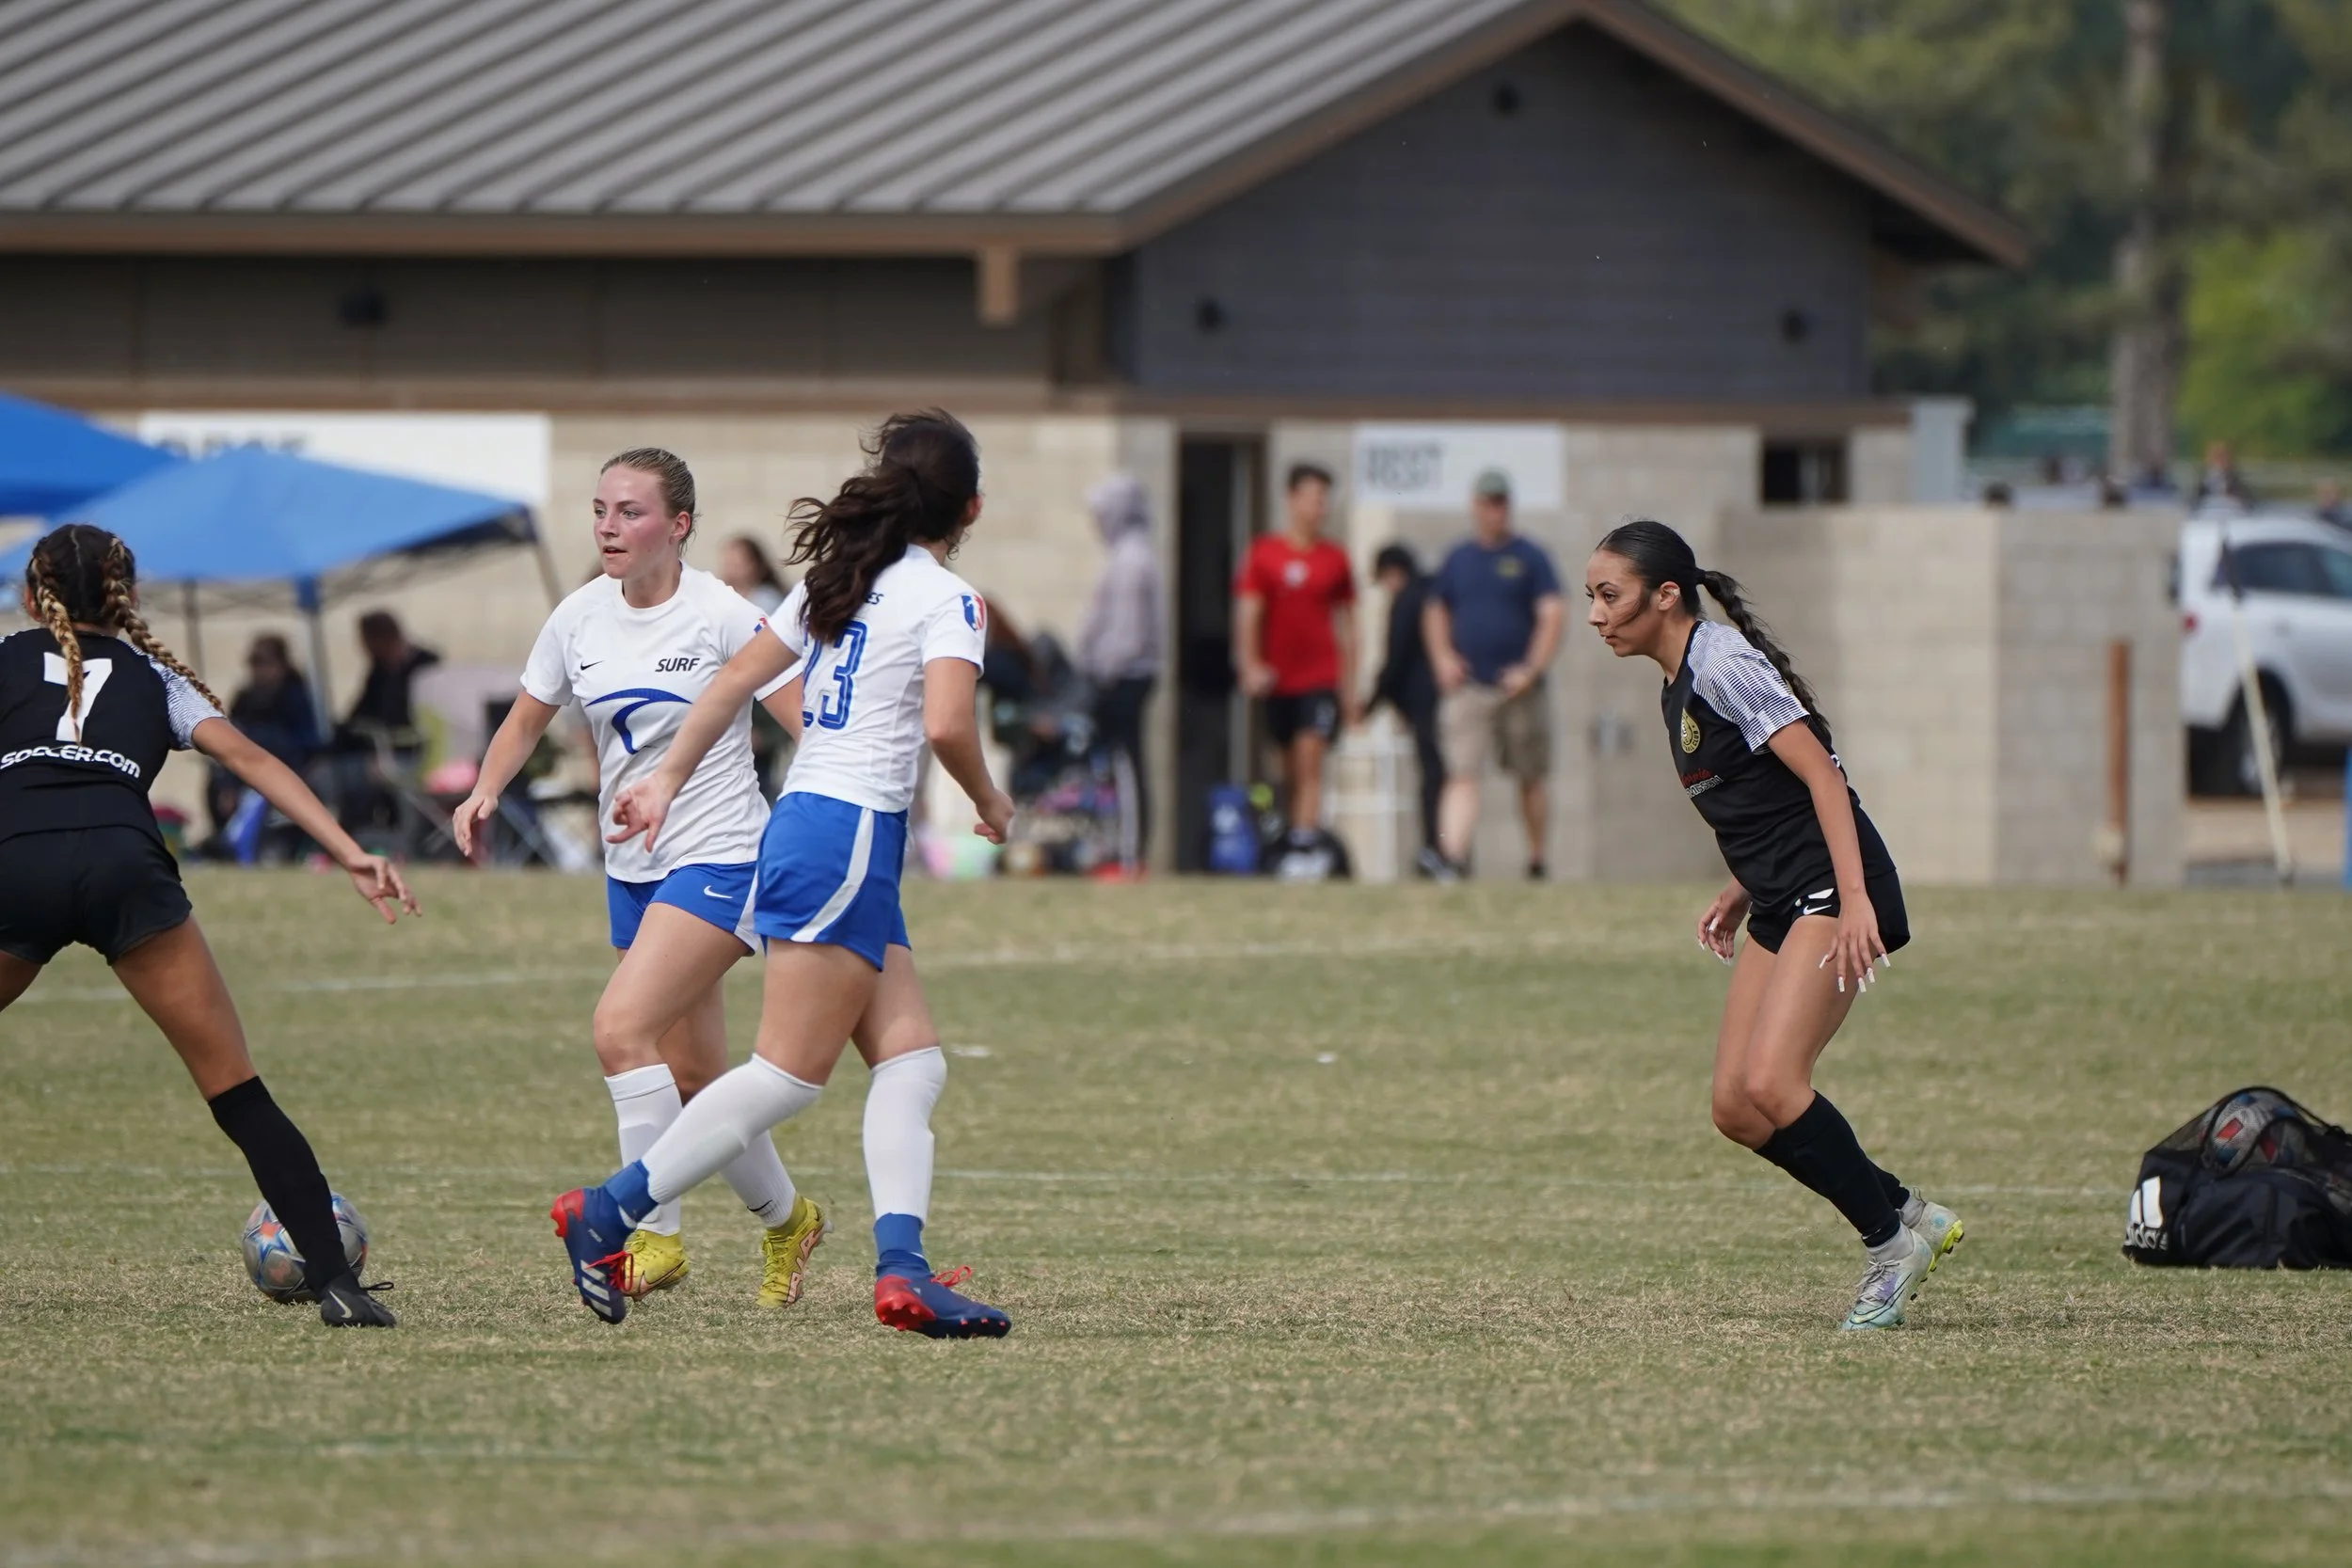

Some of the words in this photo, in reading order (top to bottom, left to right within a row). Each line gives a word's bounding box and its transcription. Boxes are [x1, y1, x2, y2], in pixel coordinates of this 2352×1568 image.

[655, 657, 700, 672] SURF
[43, 652, 113, 742] 7
[0, 745, 140, 778] SOCCER.COM
